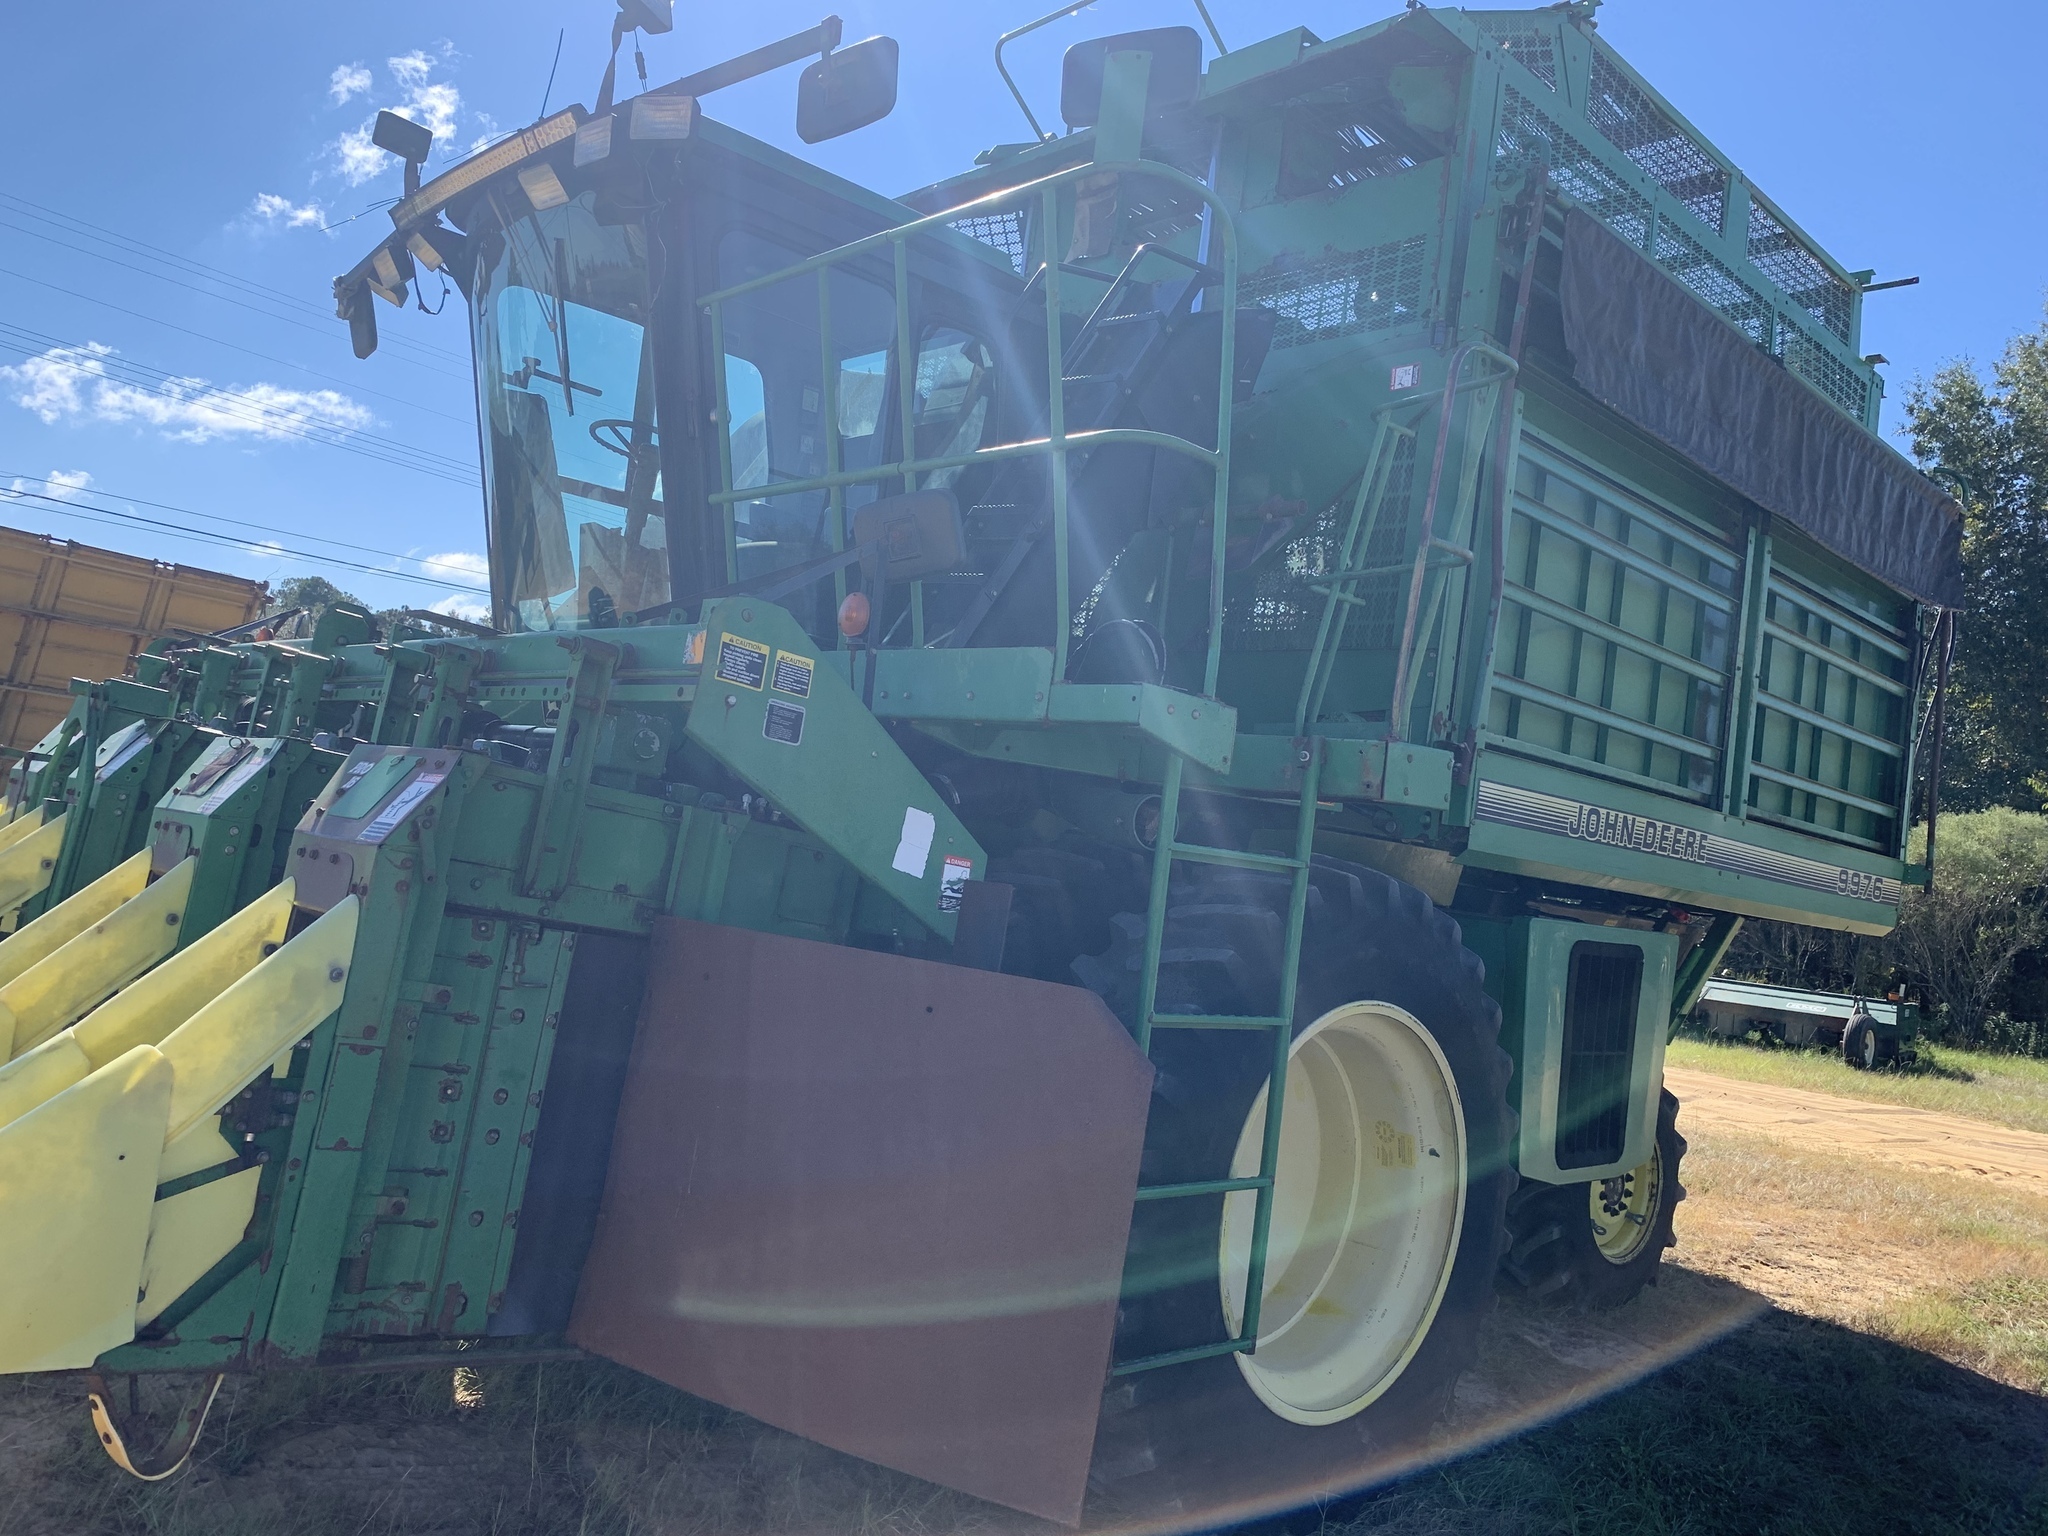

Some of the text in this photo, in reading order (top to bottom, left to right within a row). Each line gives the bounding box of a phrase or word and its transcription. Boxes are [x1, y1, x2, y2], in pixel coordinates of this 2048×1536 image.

[735, 638, 762, 651] CAUTION
[785, 656, 811, 668] CAUTION
[1567, 803, 1708, 863] JOHN DEERE
[950, 858, 971, 868] DANGER
[1837, 869, 1884, 902] 9976
